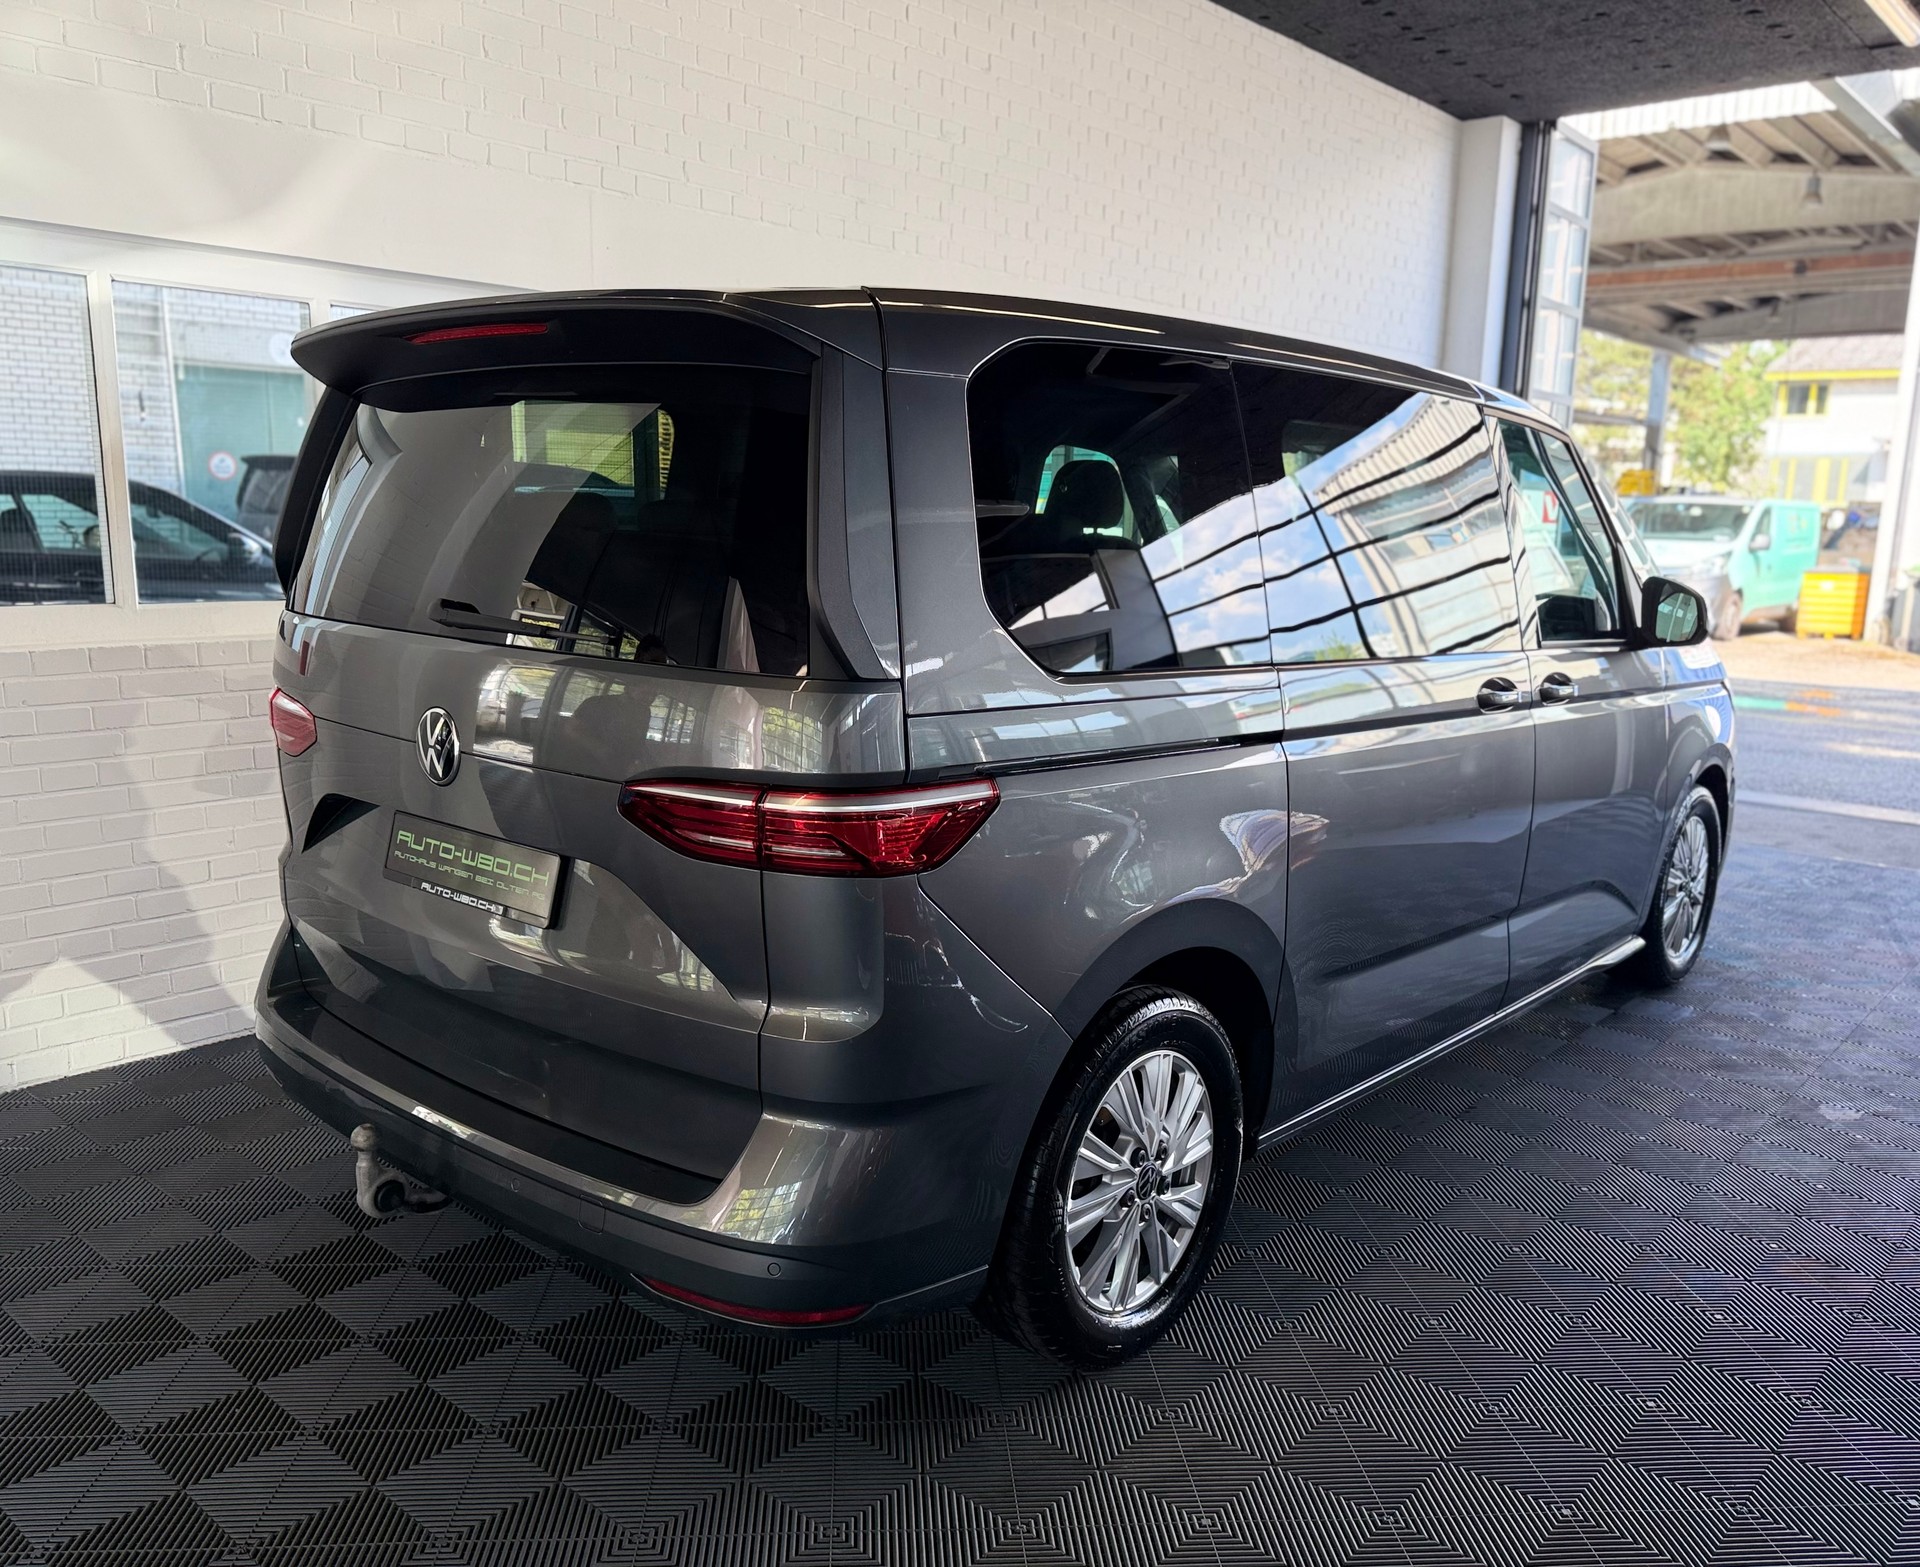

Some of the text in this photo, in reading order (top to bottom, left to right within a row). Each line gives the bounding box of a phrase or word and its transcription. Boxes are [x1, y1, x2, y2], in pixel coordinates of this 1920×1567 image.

[394, 850, 437, 869] AUTOHAUS
[438, 863, 474, 880] WANGEN
[475, 874, 495, 886] BEI
[496, 881, 530, 896] OLTEN
